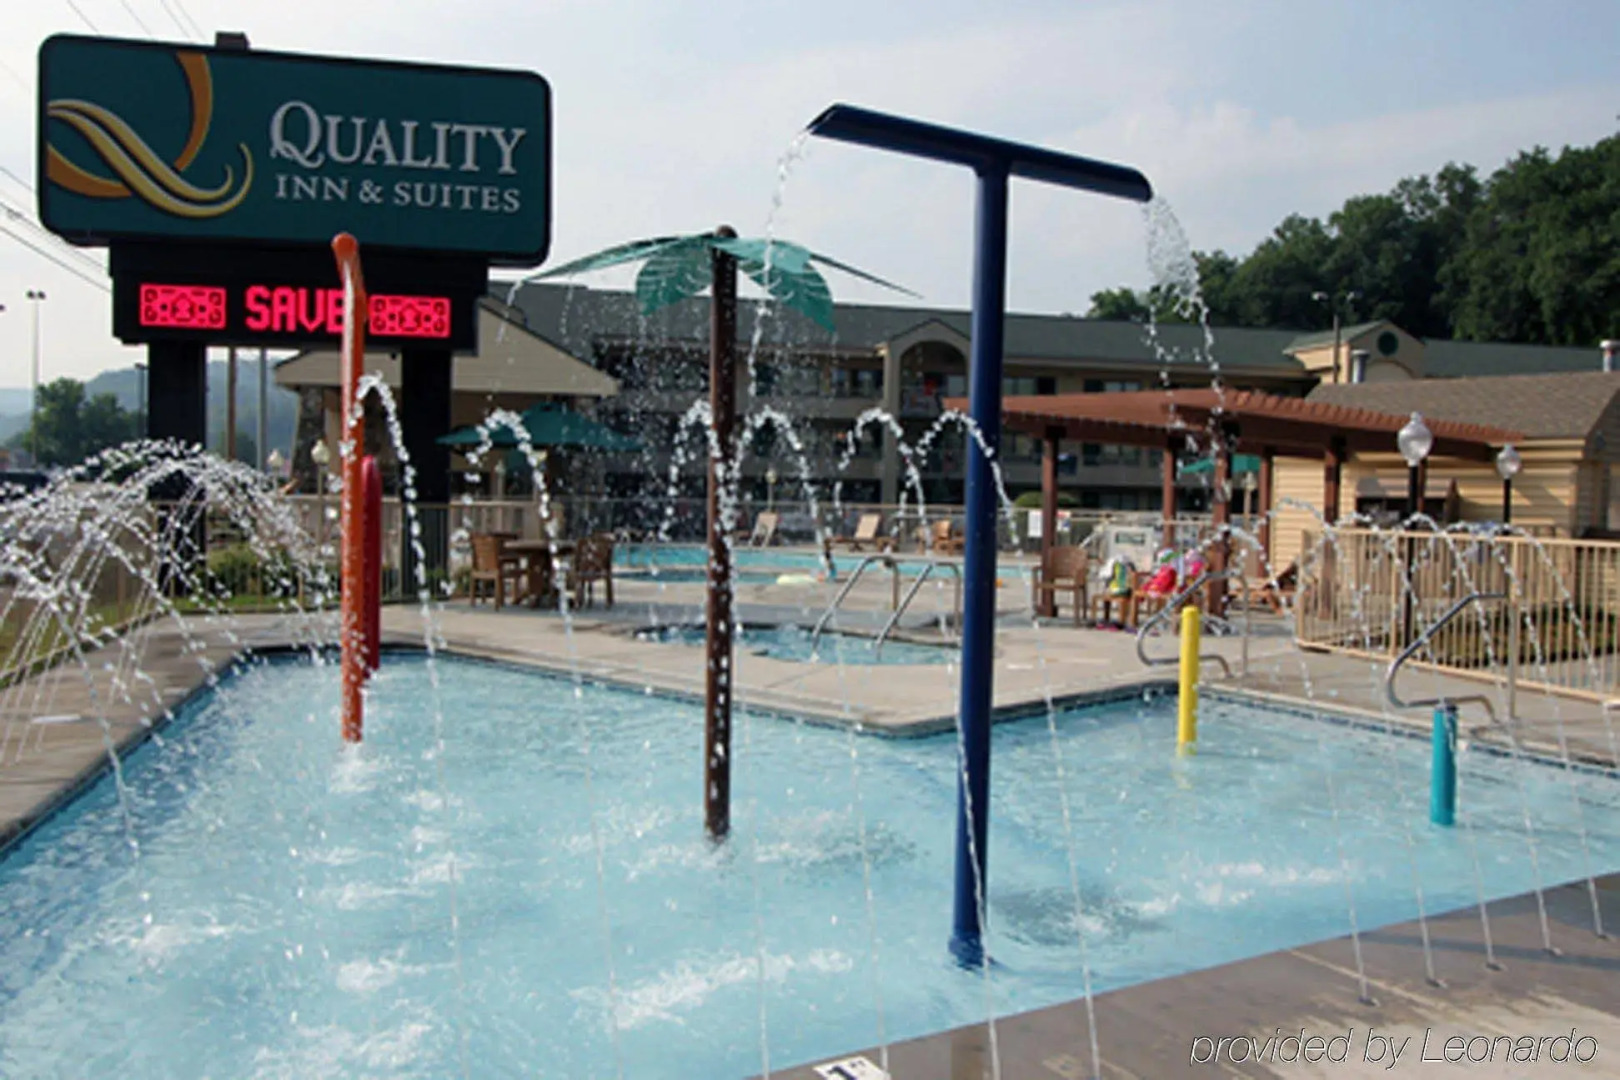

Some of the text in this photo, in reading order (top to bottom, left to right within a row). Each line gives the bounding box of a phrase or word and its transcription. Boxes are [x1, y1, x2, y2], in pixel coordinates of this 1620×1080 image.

[270, 101, 526, 174] QUALITY
[276, 175, 521, 213] INN & SUITES
[245, 286, 347, 332] SAVE
